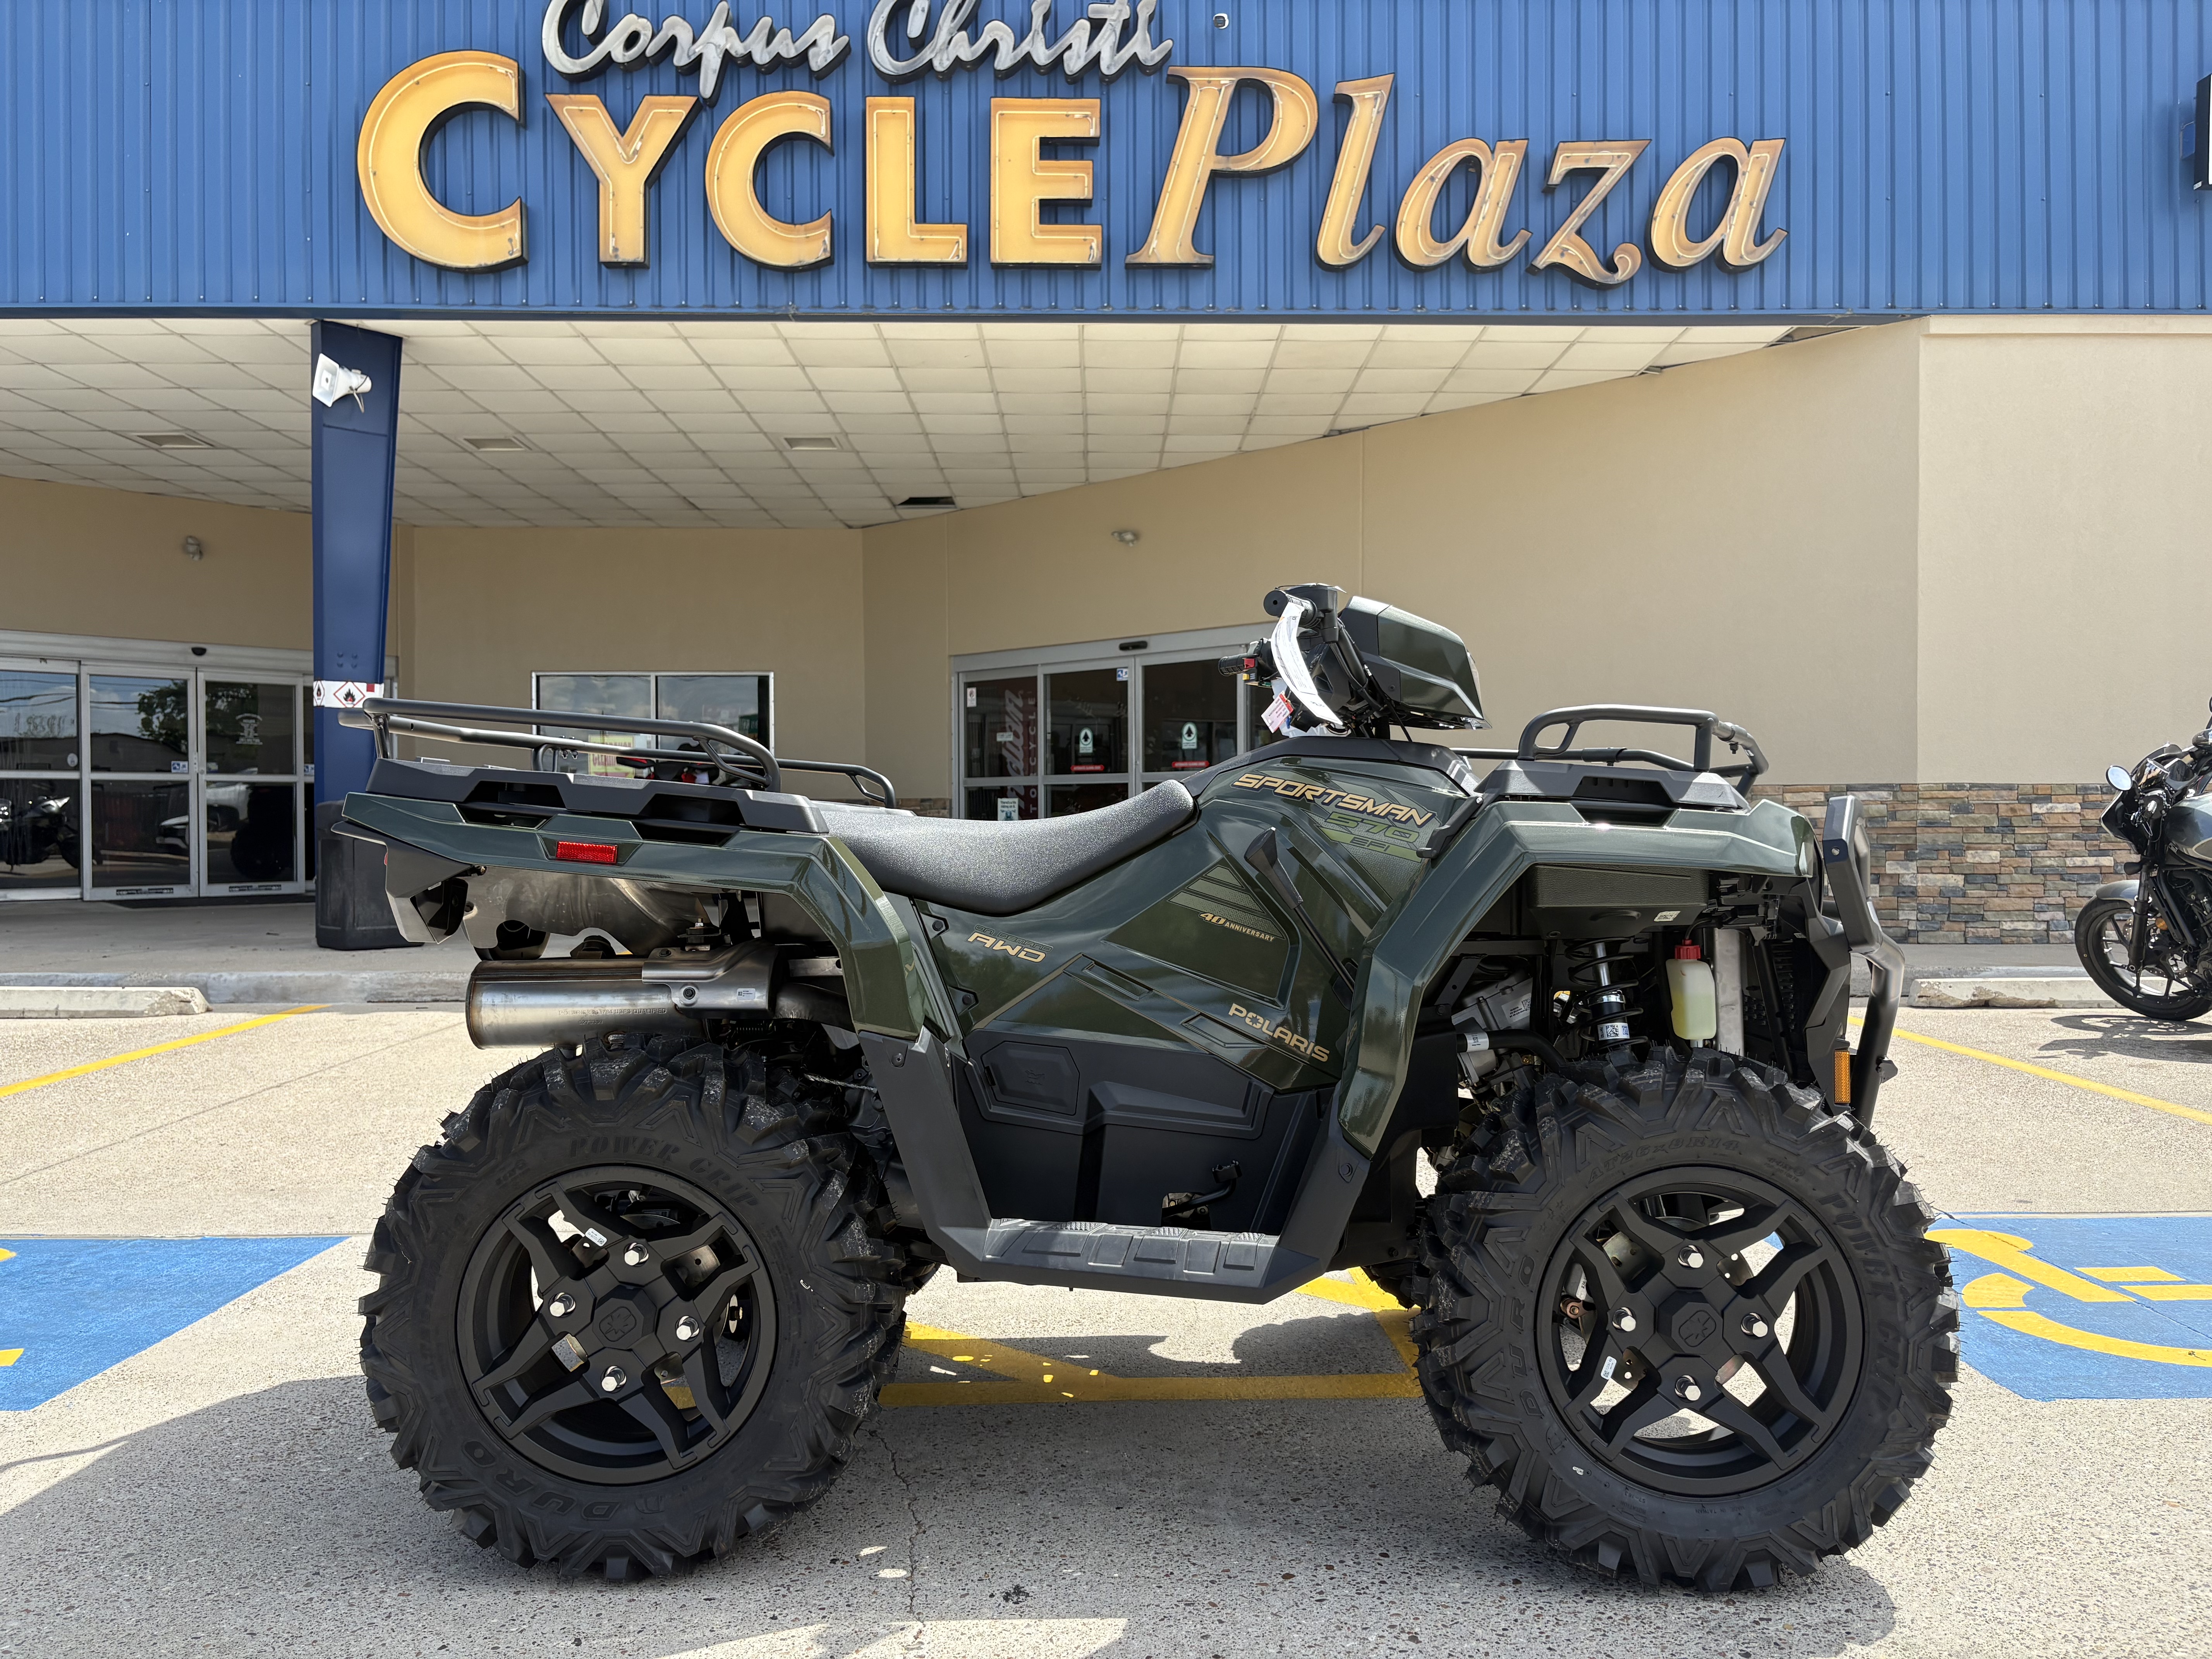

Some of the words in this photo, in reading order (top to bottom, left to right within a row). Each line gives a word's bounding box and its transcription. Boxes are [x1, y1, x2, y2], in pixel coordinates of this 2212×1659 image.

[542, 0, 850, 100] Corpus
[868, 0, 1173, 79] Christi
[358, 49, 1102, 270] CYCLE
[1126, 65, 1788, 287] Plaza
[1232, 773, 1434, 826] SPORTSMAN
[1325, 812, 1420, 844] 570
[1349, 836, 1391, 852] EFI
[967, 932, 1046, 962] AWD
[974, 924, 995, 935] ON
[997, 932, 1054, 952] DEMAND
[1224, 922, 1274, 941] ANNIVERSARY
[1228, 1003, 1330, 1062] POLARIS
[565, 1133, 685, 1165] POWER
[685, 1151, 761, 1214] GRIP
[1817, 1182, 1897, 1305] POWER
[1862, 1318, 1903, 1413] GRIP
[1507, 1253, 1544, 1423] DURO
[458, 1432, 622, 1525] DURO
